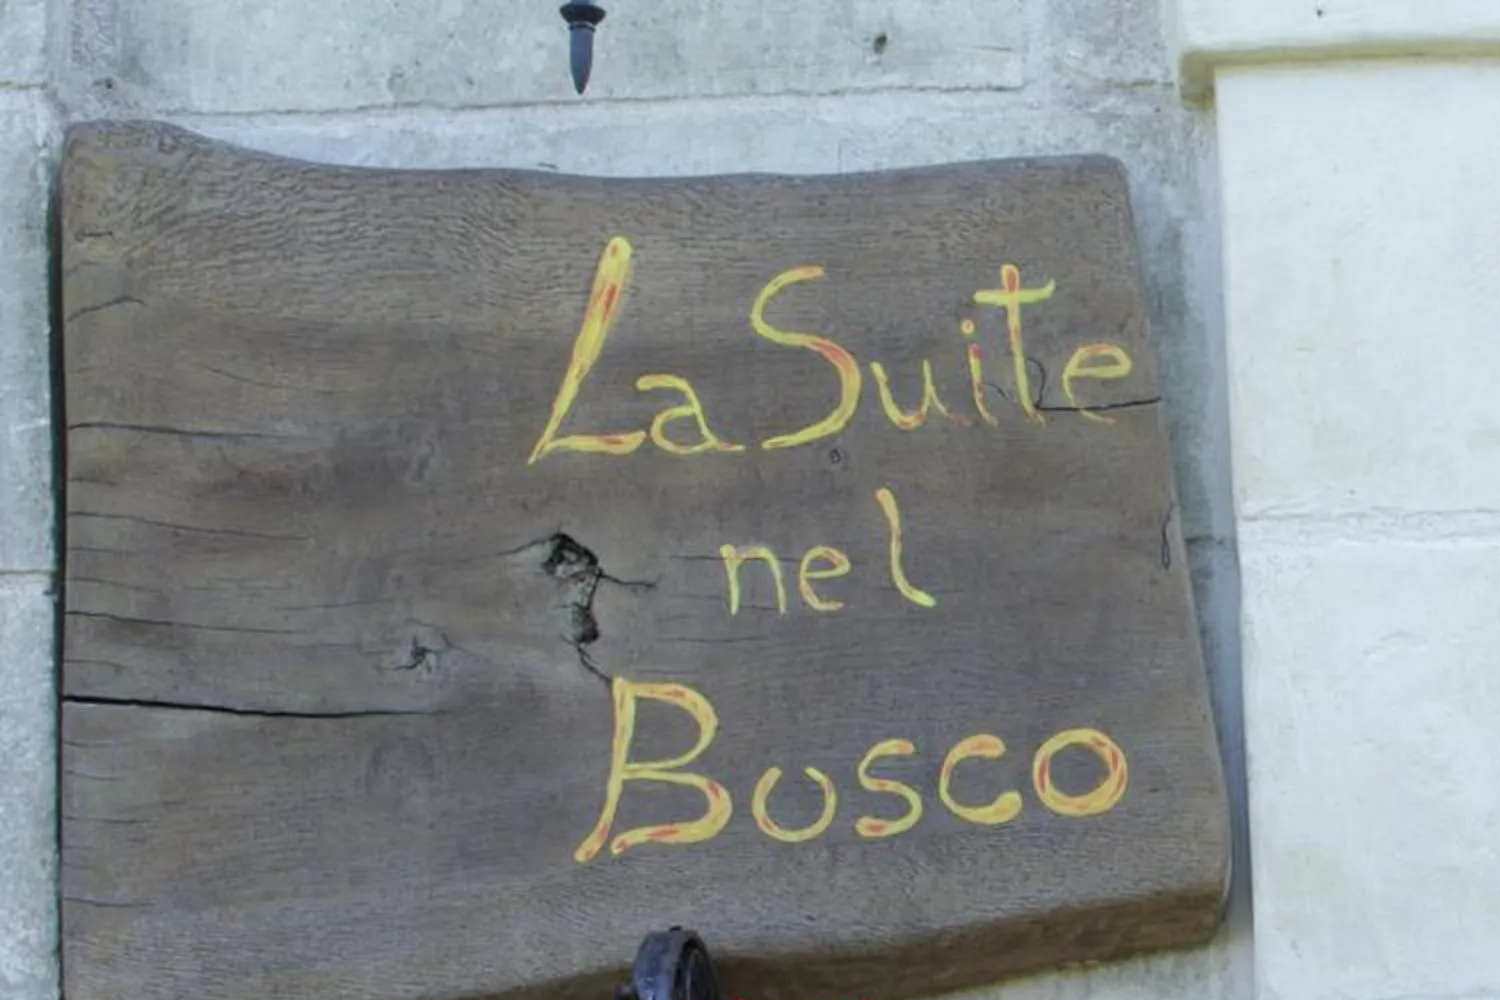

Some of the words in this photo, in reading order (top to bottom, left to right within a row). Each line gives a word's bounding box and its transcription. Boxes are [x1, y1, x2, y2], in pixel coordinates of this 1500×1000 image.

[528, 236, 745, 464] La
[750, 264, 1132, 450] Suite
[719, 487, 936, 615] nel
[574, 676, 1128, 862] Bosco
